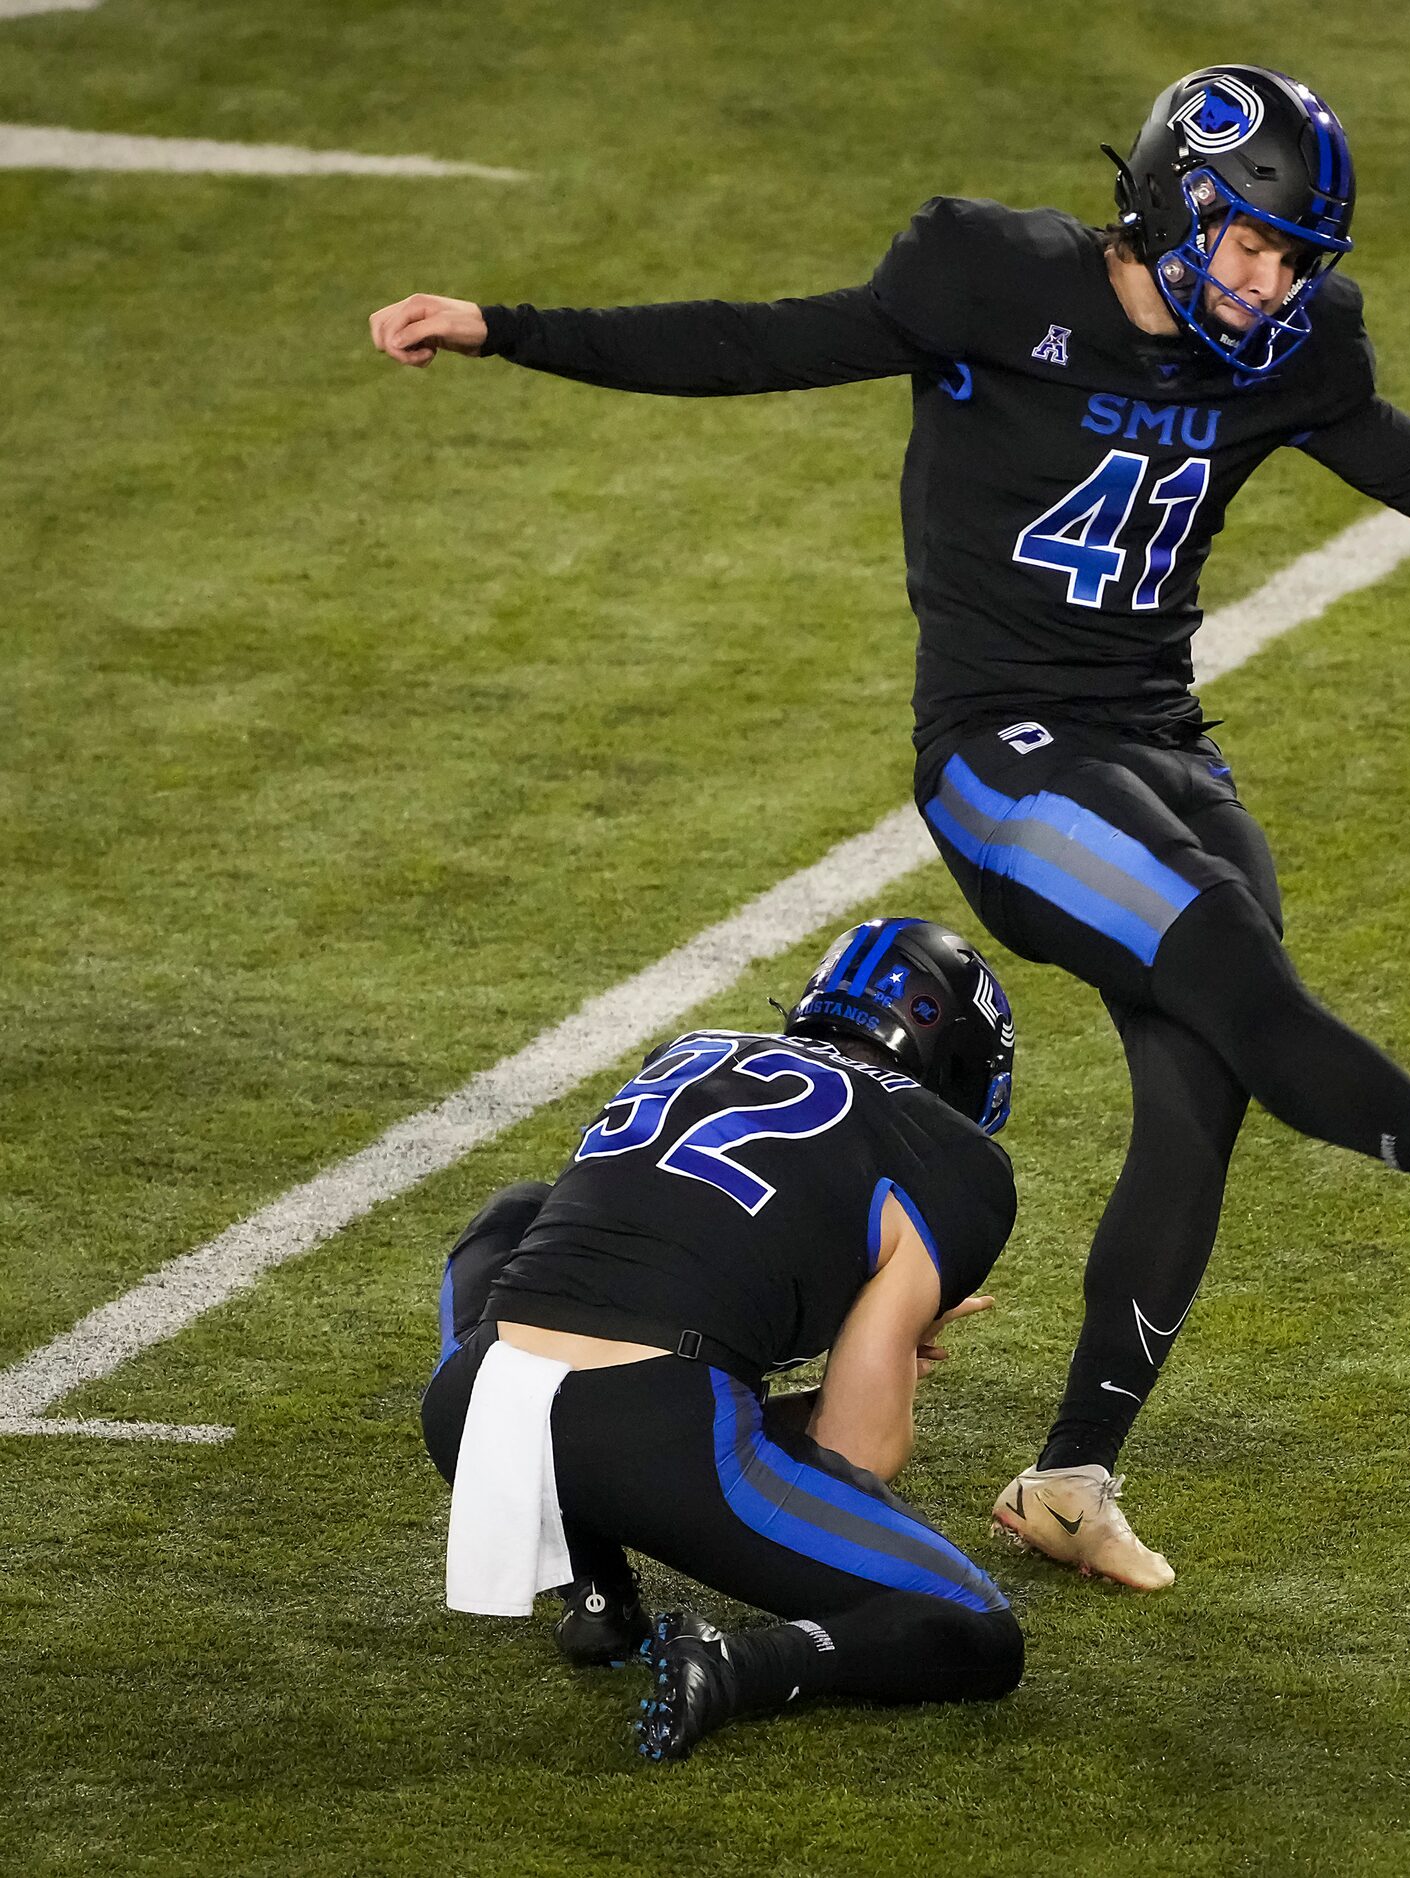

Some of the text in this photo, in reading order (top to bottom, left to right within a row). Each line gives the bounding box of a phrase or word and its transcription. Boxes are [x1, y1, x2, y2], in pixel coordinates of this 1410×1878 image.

[1031, 324, 1072, 366] A
[1080, 393, 1222, 450] SMU
[1012, 448, 1211, 611] 41
[874, 964, 911, 1000] A
[573, 1036, 854, 1218] 92
